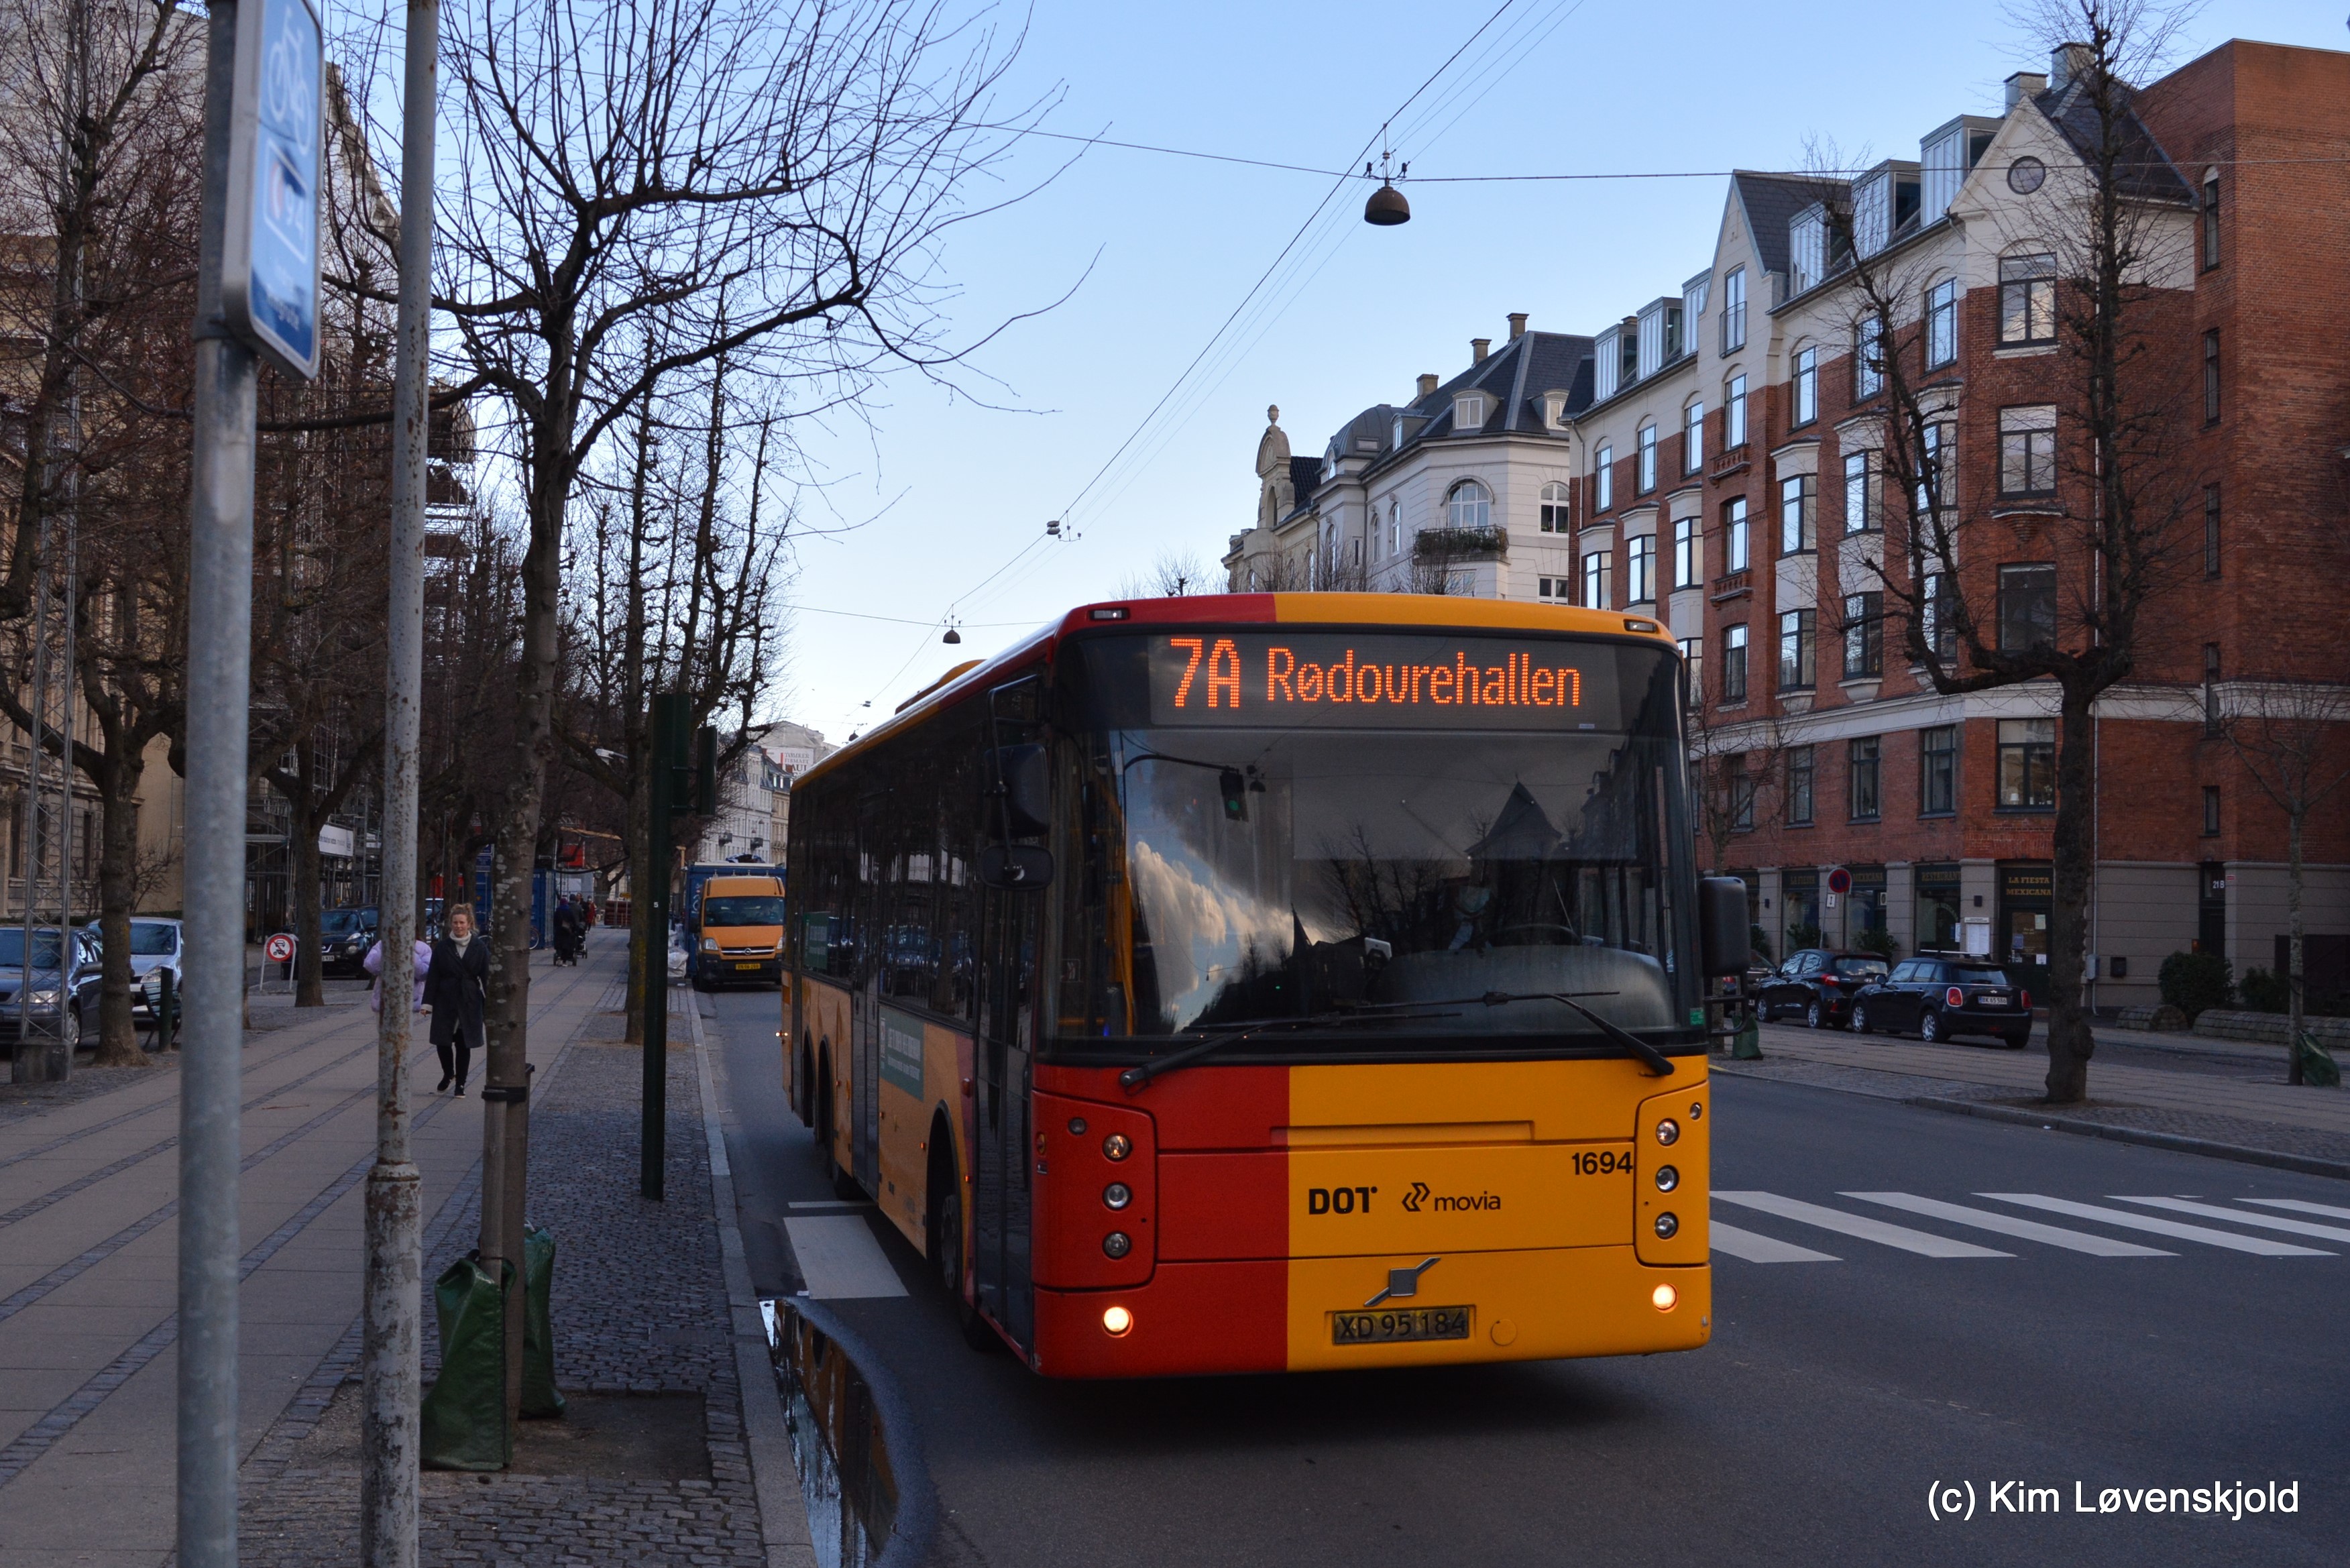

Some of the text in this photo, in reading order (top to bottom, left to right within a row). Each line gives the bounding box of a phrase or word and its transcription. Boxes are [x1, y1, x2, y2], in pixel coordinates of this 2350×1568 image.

[1170, 638, 1580, 708] 7A Rødovrehallen
[2006, 888, 2052, 896] MEXICANA
[2213, 880, 2225, 889] 21 B
[1571, 1152, 1634, 1176] 1694
[1308, 1186, 1378, 1215] DOT
[1435, 1190, 1501, 1211] movia
[1340, 1312, 1465, 1339] XD 95 184
